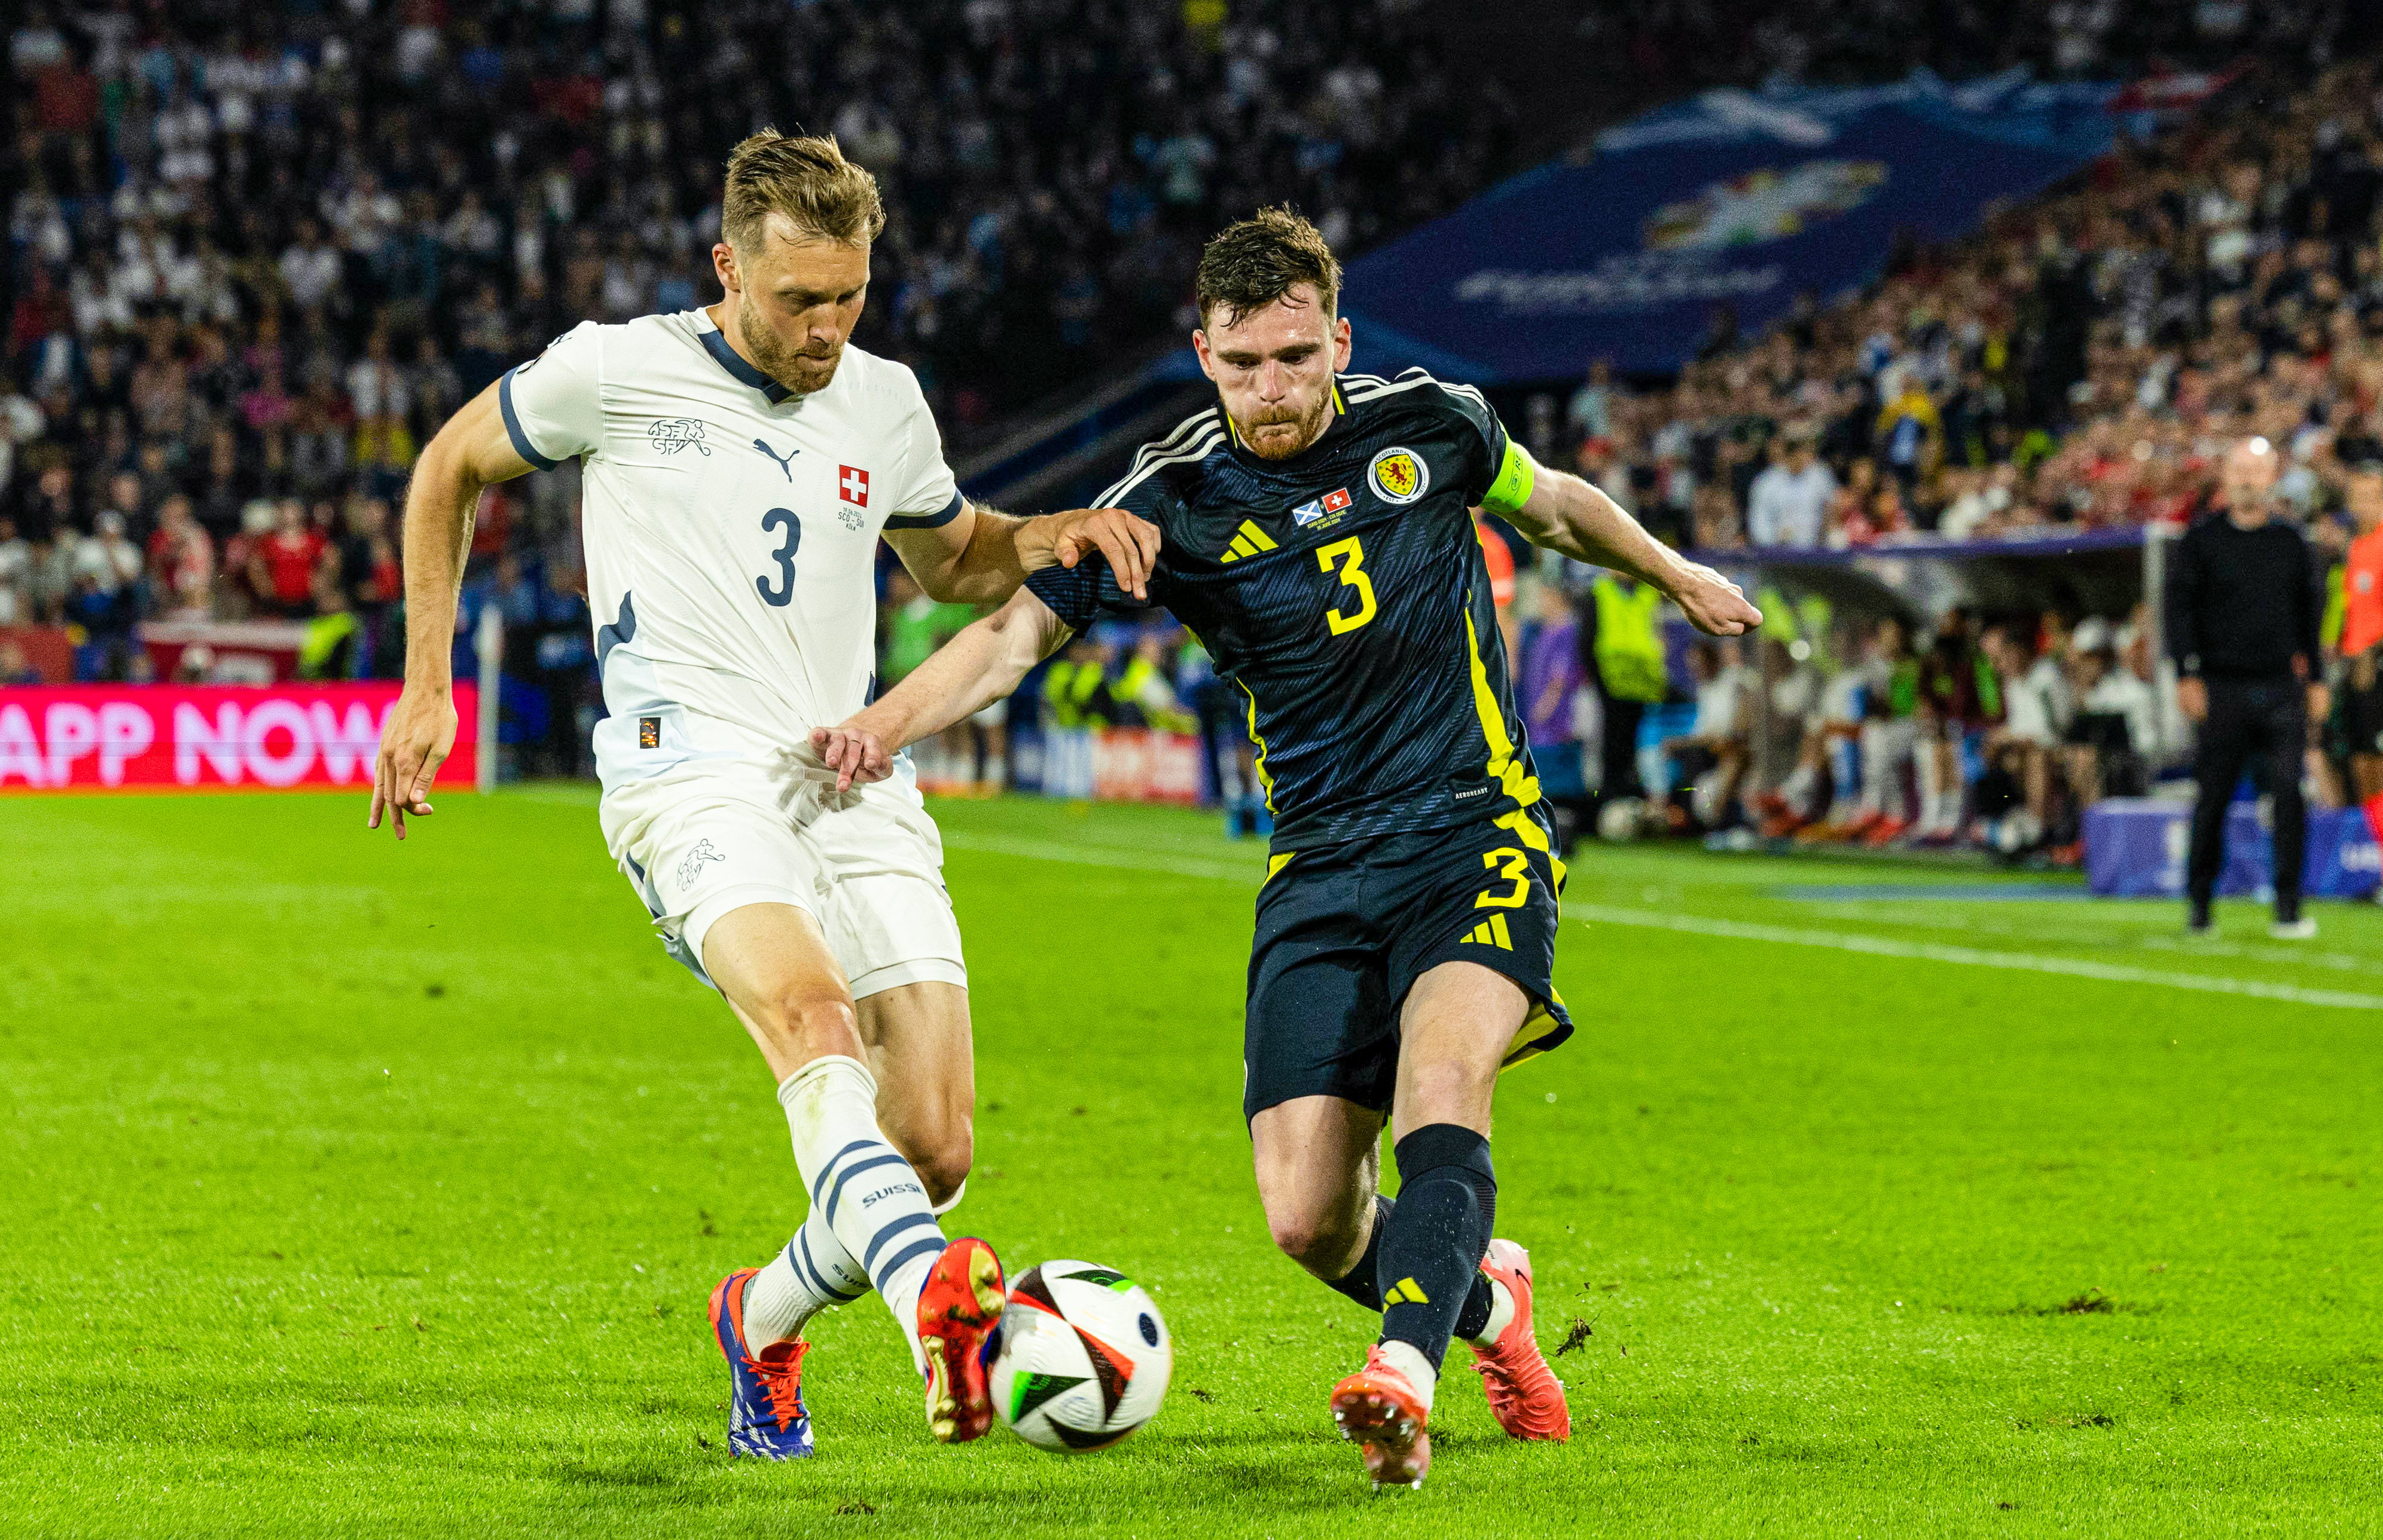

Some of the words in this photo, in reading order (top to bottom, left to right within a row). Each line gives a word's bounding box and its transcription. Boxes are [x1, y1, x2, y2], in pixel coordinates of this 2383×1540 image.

[1376, 449, 1404, 461] SCOTLAND
[838, 512, 850, 522] SCO
[856, 518, 865, 528] SUI
[756, 508, 801, 607] 3
[1316, 536, 1377, 637] 3
[0, 702, 155, 788] APP
[173, 698, 399, 787] NOW
[1455, 787, 1488, 799] AEROREADY
[1475, 847, 1530, 909] 3
